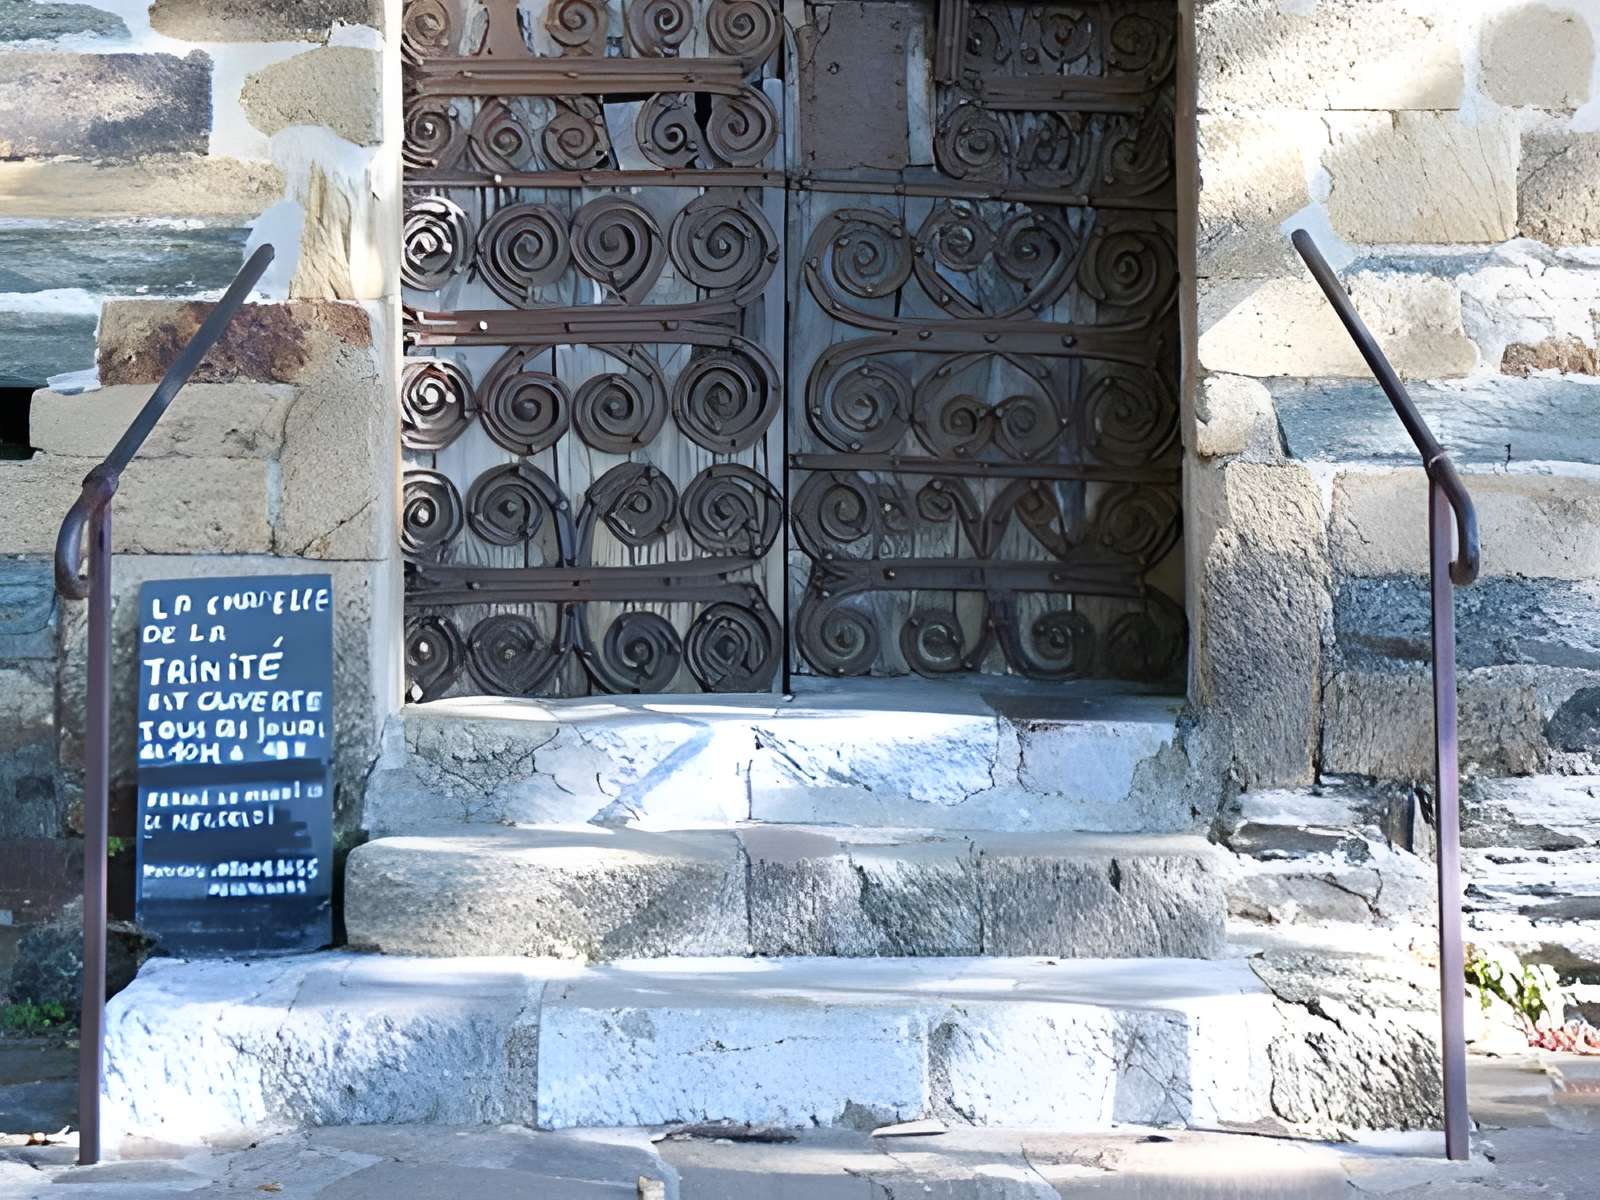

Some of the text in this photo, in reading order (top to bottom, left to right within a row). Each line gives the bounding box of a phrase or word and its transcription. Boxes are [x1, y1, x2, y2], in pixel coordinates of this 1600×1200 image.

[152, 595, 192, 620] LA
[143, 623, 226, 644] DE LA
[197, 690, 322, 712] OUVERTE
[139, 720, 206, 741] TOUS
